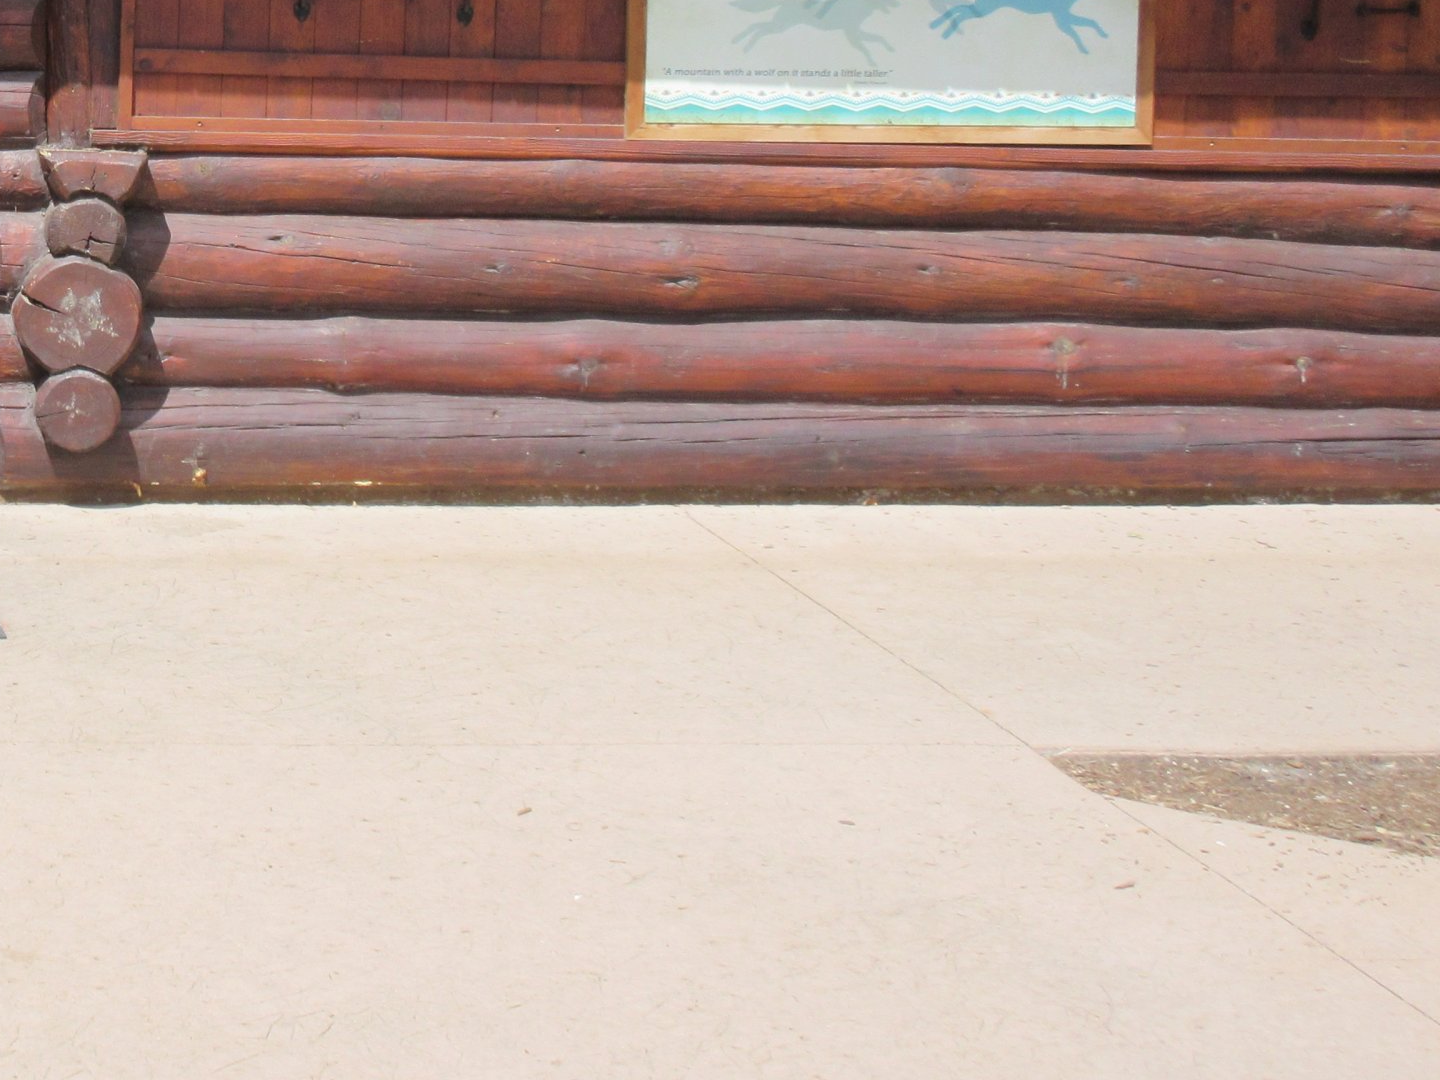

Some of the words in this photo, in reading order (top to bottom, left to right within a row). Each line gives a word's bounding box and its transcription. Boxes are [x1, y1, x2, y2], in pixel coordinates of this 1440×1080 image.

[674, 67, 721, 77] mountain
[723, 67, 744, 77] with
[754, 67, 776, 78] wolf
[777, 69, 790, 78] on
[799, 68, 832, 78] stands
[840, 68, 861, 78] little
